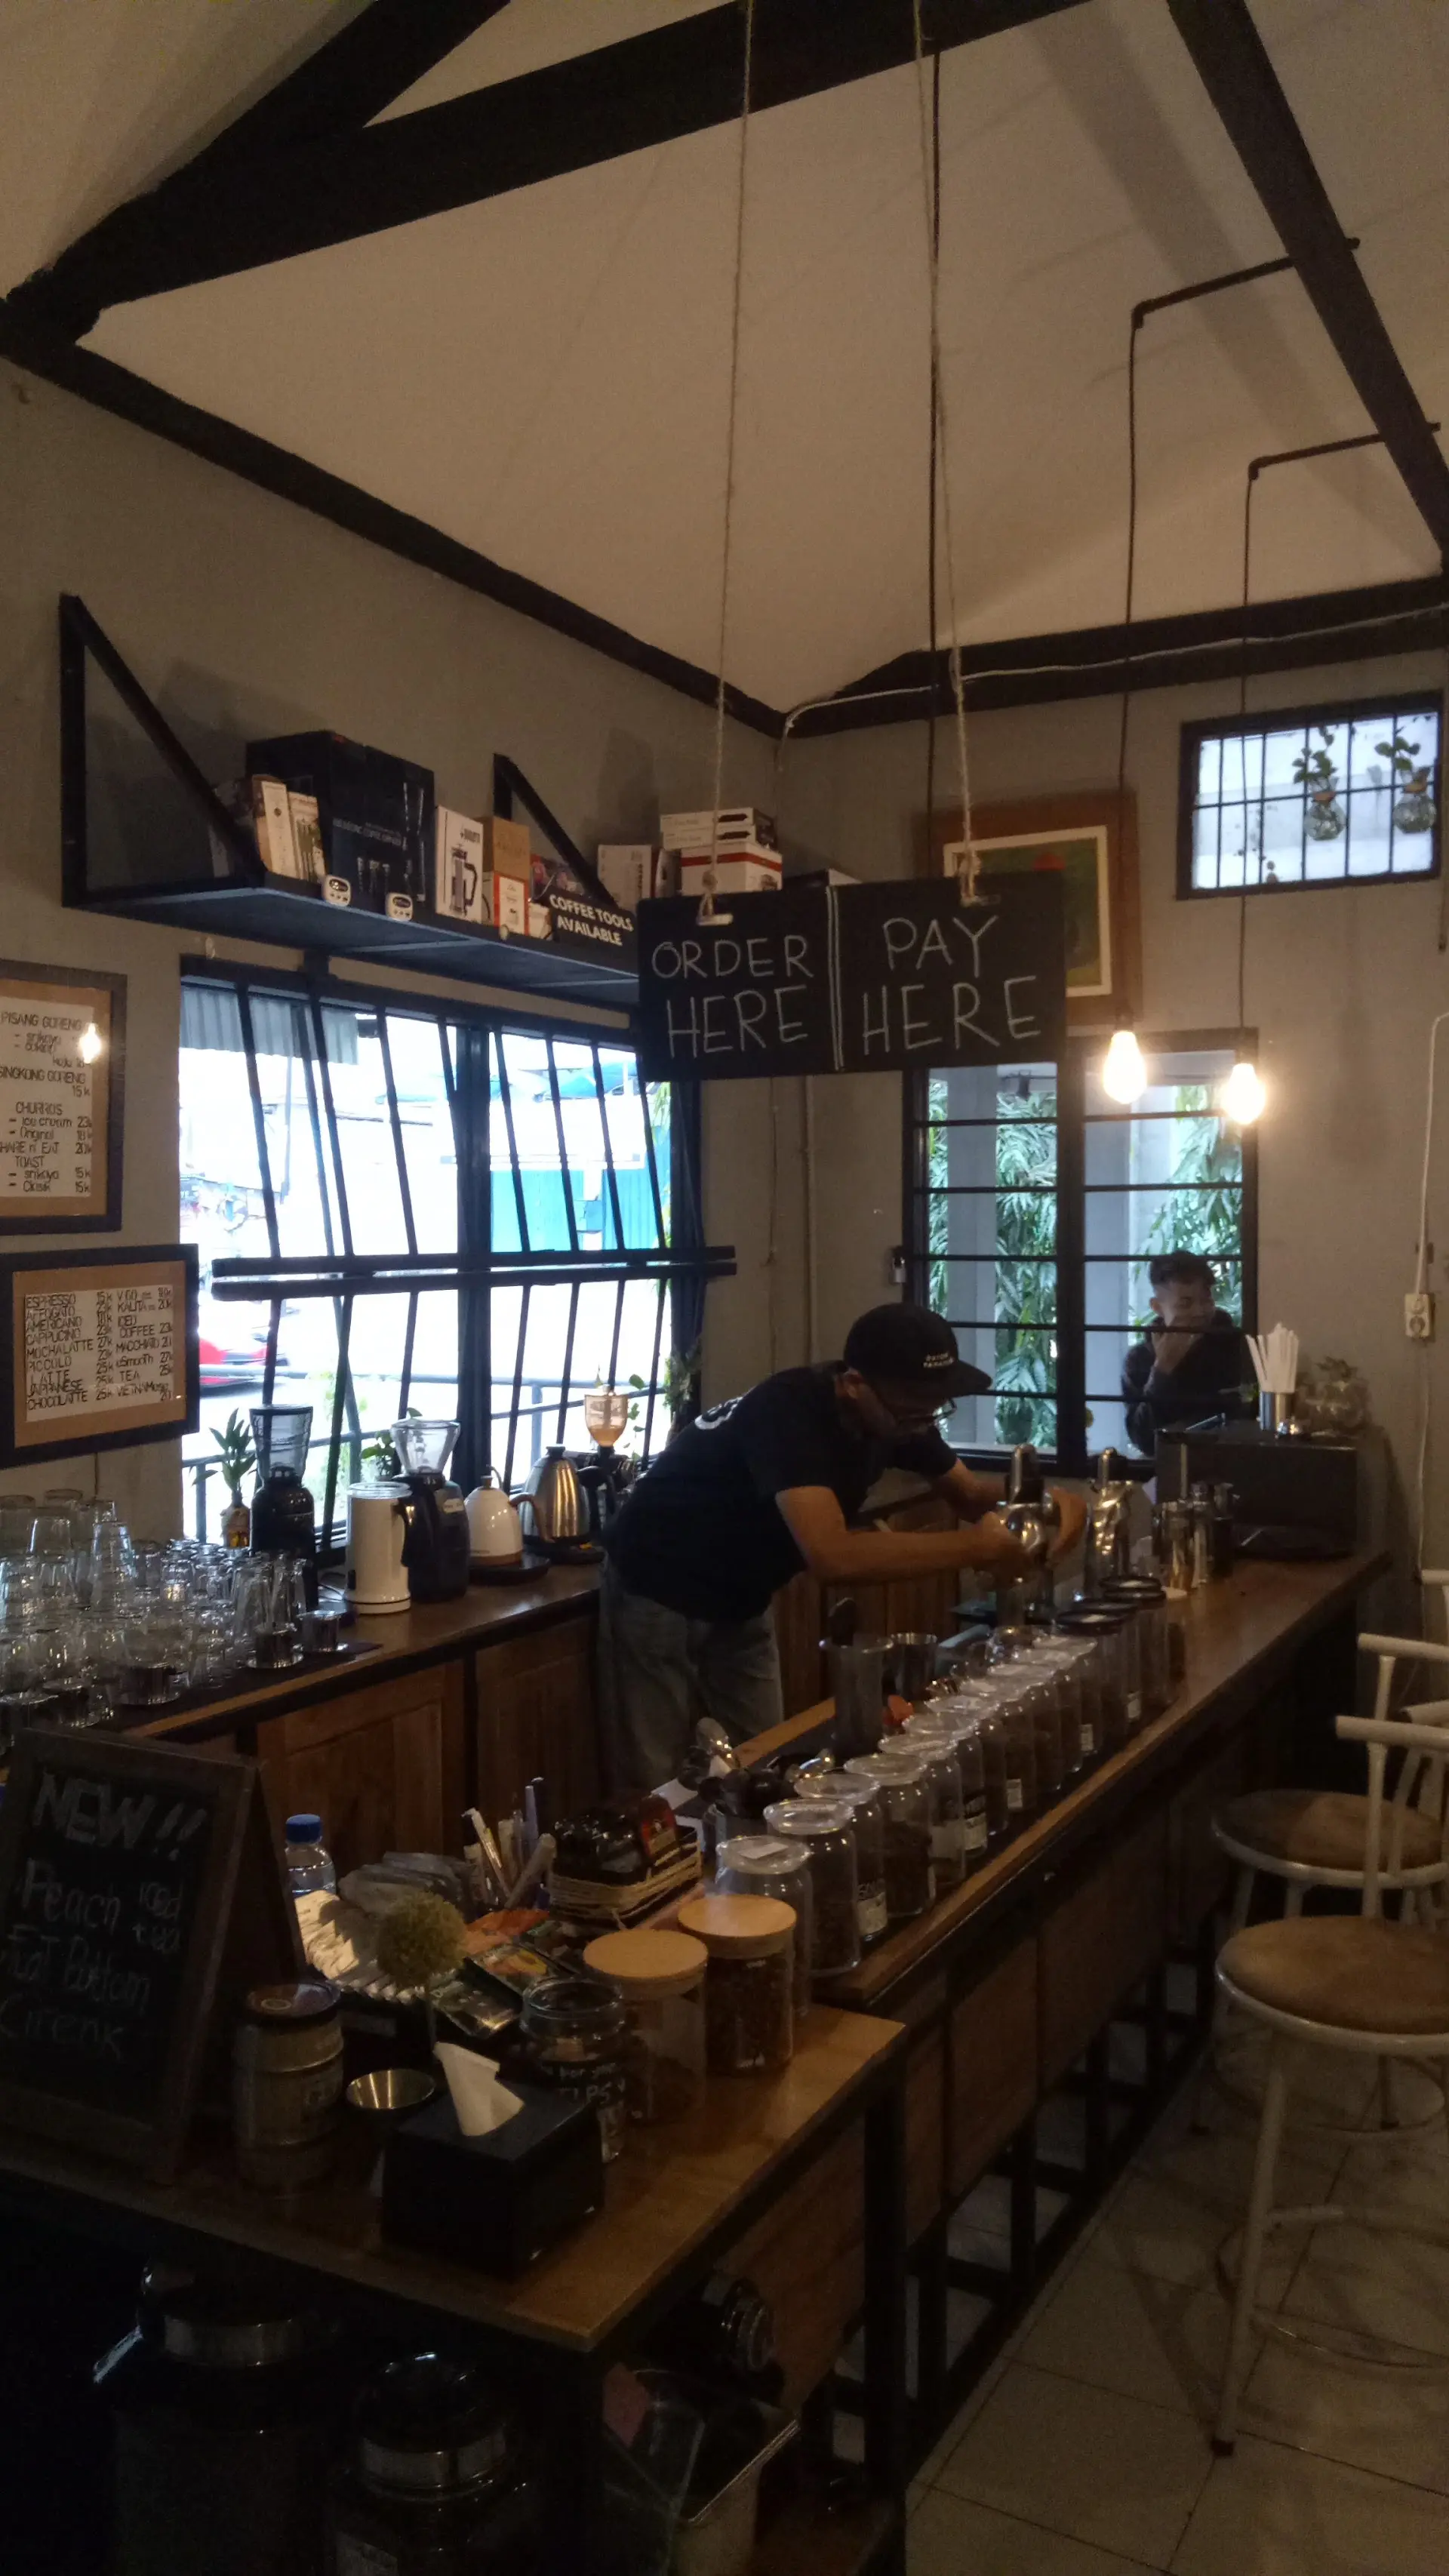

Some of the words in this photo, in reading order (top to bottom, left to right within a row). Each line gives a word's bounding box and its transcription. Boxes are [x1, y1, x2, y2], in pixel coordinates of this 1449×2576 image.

[549, 893, 598, 921] COFFEE
[596, 908, 634, 932] TOOLS
[556, 914, 623, 946] AVAILABLE
[651, 934, 814, 979] ORDER
[881, 915, 998, 977] PAY
[1, 1011, 39, 1026] PISANG
[666, 984, 808, 1058] HERE
[863, 975, 1042, 1055] HERE
[15, 1100, 63, 1116] CHURROS
[15, 1155, 45, 1168] TOAST
[26, 1293, 76, 1309] ESPRESSO
[119, 1324, 155, 1338] COFFEE
[30, 1369, 70, 1387] LATTE
[119, 1369, 140, 1382] TEA
[22, 1857, 122, 1936] Peach
